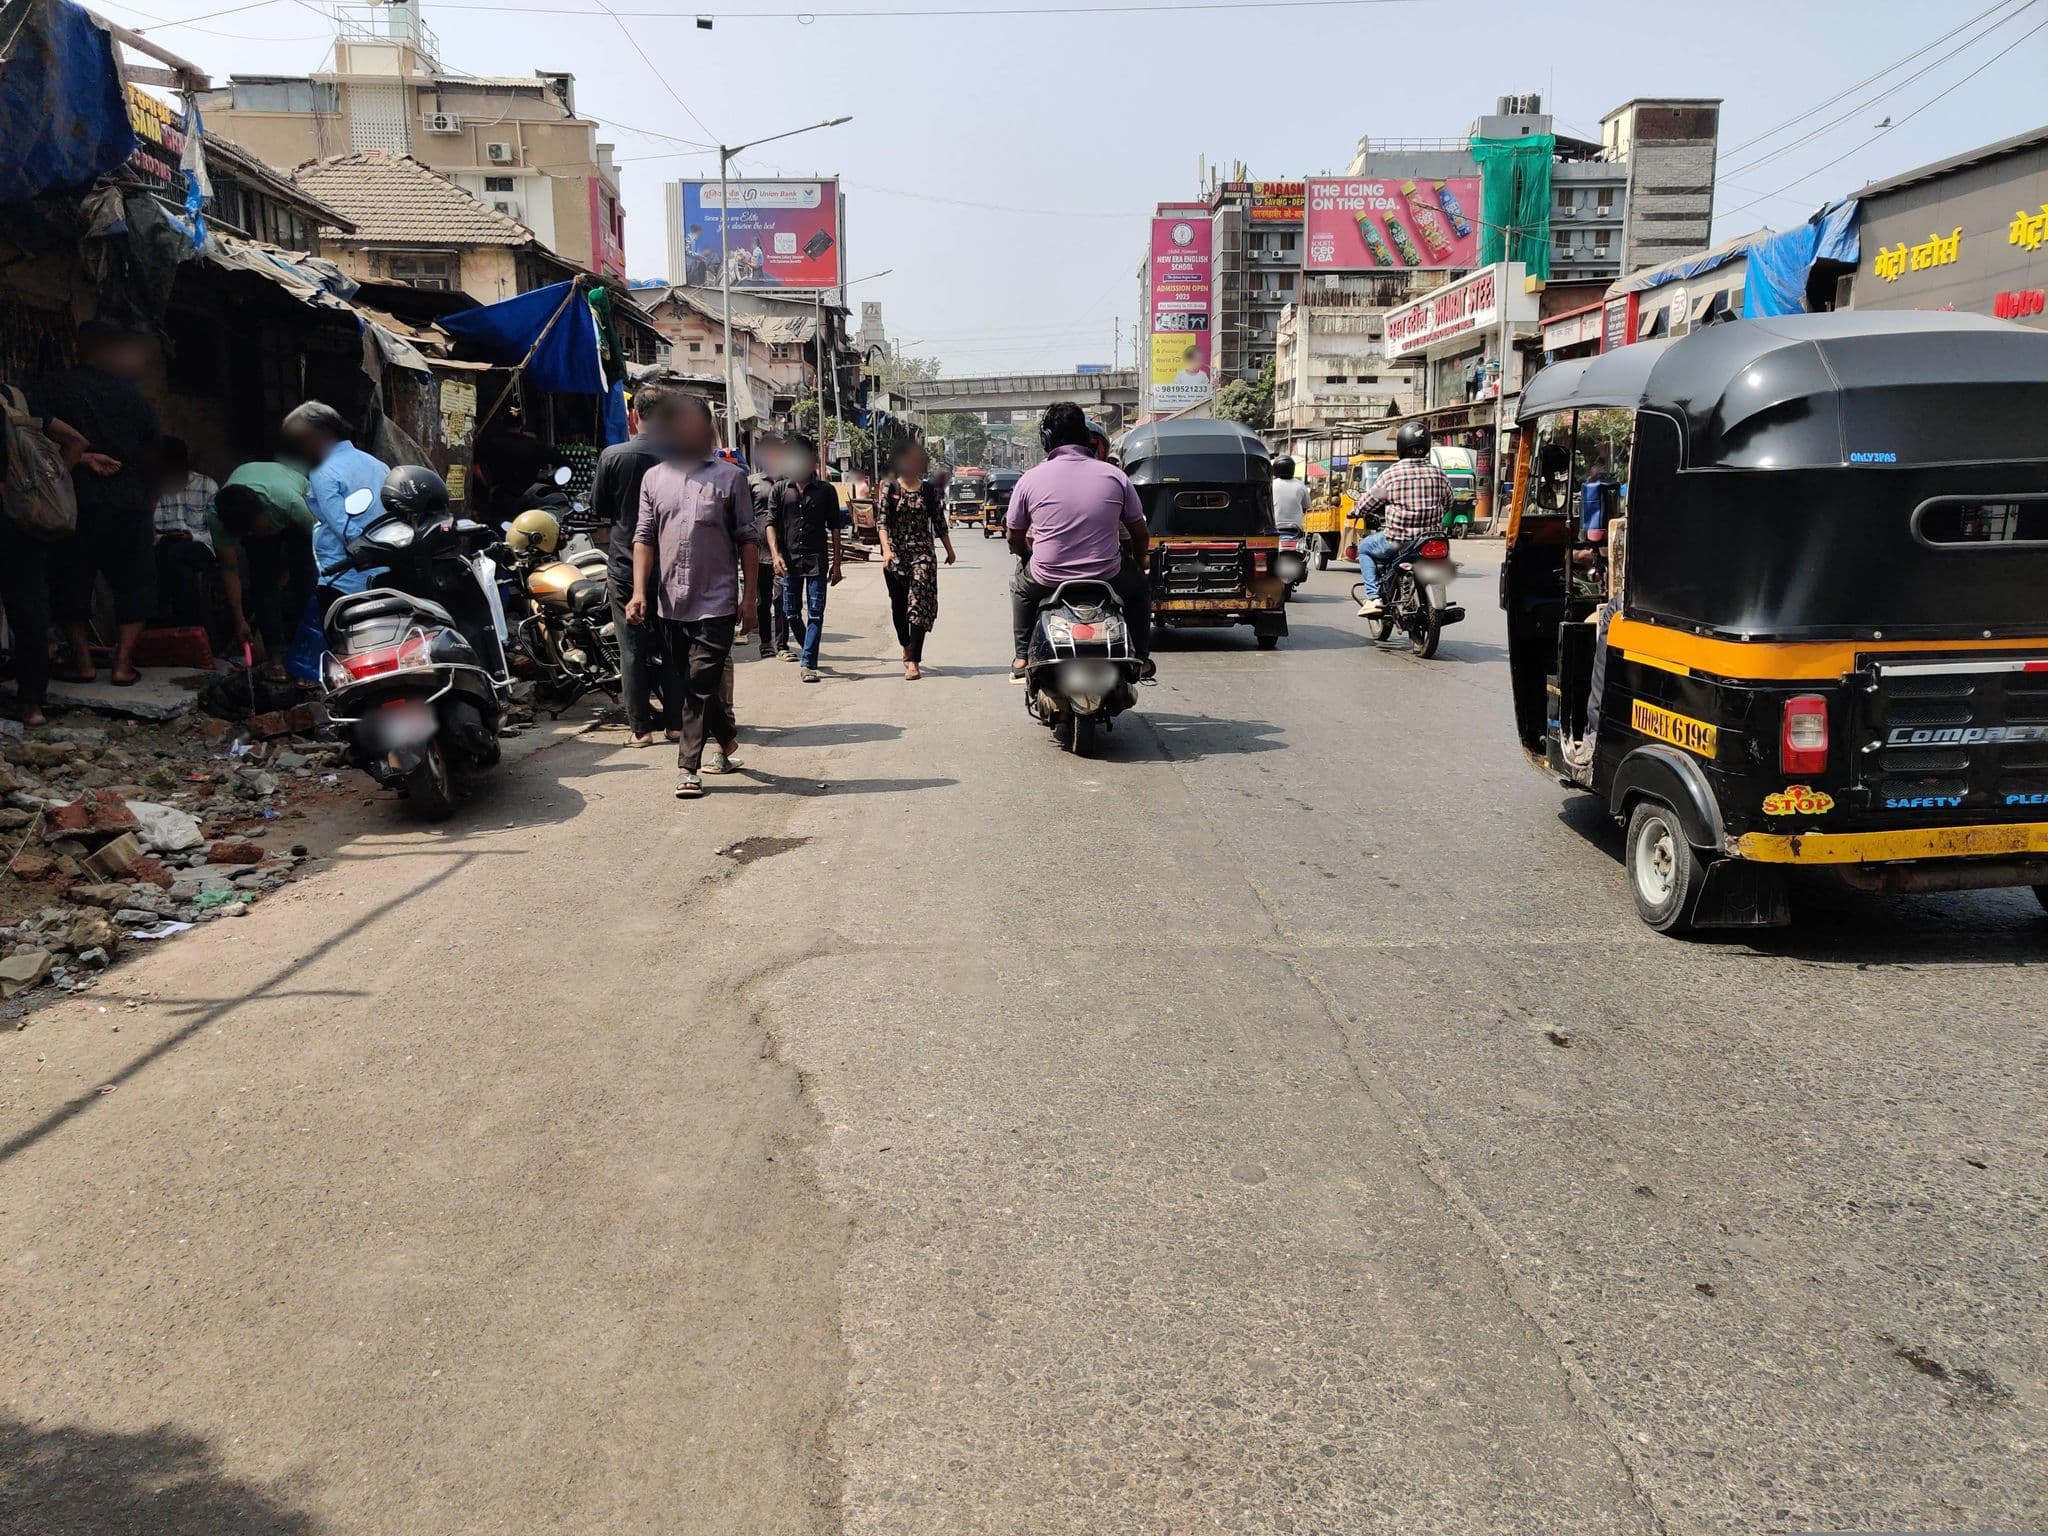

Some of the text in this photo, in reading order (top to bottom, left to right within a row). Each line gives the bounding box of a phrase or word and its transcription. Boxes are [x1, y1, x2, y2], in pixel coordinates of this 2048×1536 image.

[1227, 183, 1248, 192] HOTEL
[1344, 183, 1385, 197] ICING
[760, 189, 798, 198] Union Bank
[1264, 198, 1287, 206] SAVING
[1312, 198, 1334, 211] ON
[1157, 255, 1209, 263] NEW ERA ENGLISH
[1874, 226, 1964, 284] मेट्रो स्टोर्स
[1171, 263, 1194, 271] SCHOOL
[1157, 284, 1209, 292] ADMISSION OPEN
[1435, 276, 1495, 326] BHARAT STEEL
[1993, 288, 2046, 319] Metro
[1161, 385, 1208, 393] 9819521233
[1763, 797, 1834, 812] STOP
[1885, 796, 1962, 809] SAFETY
